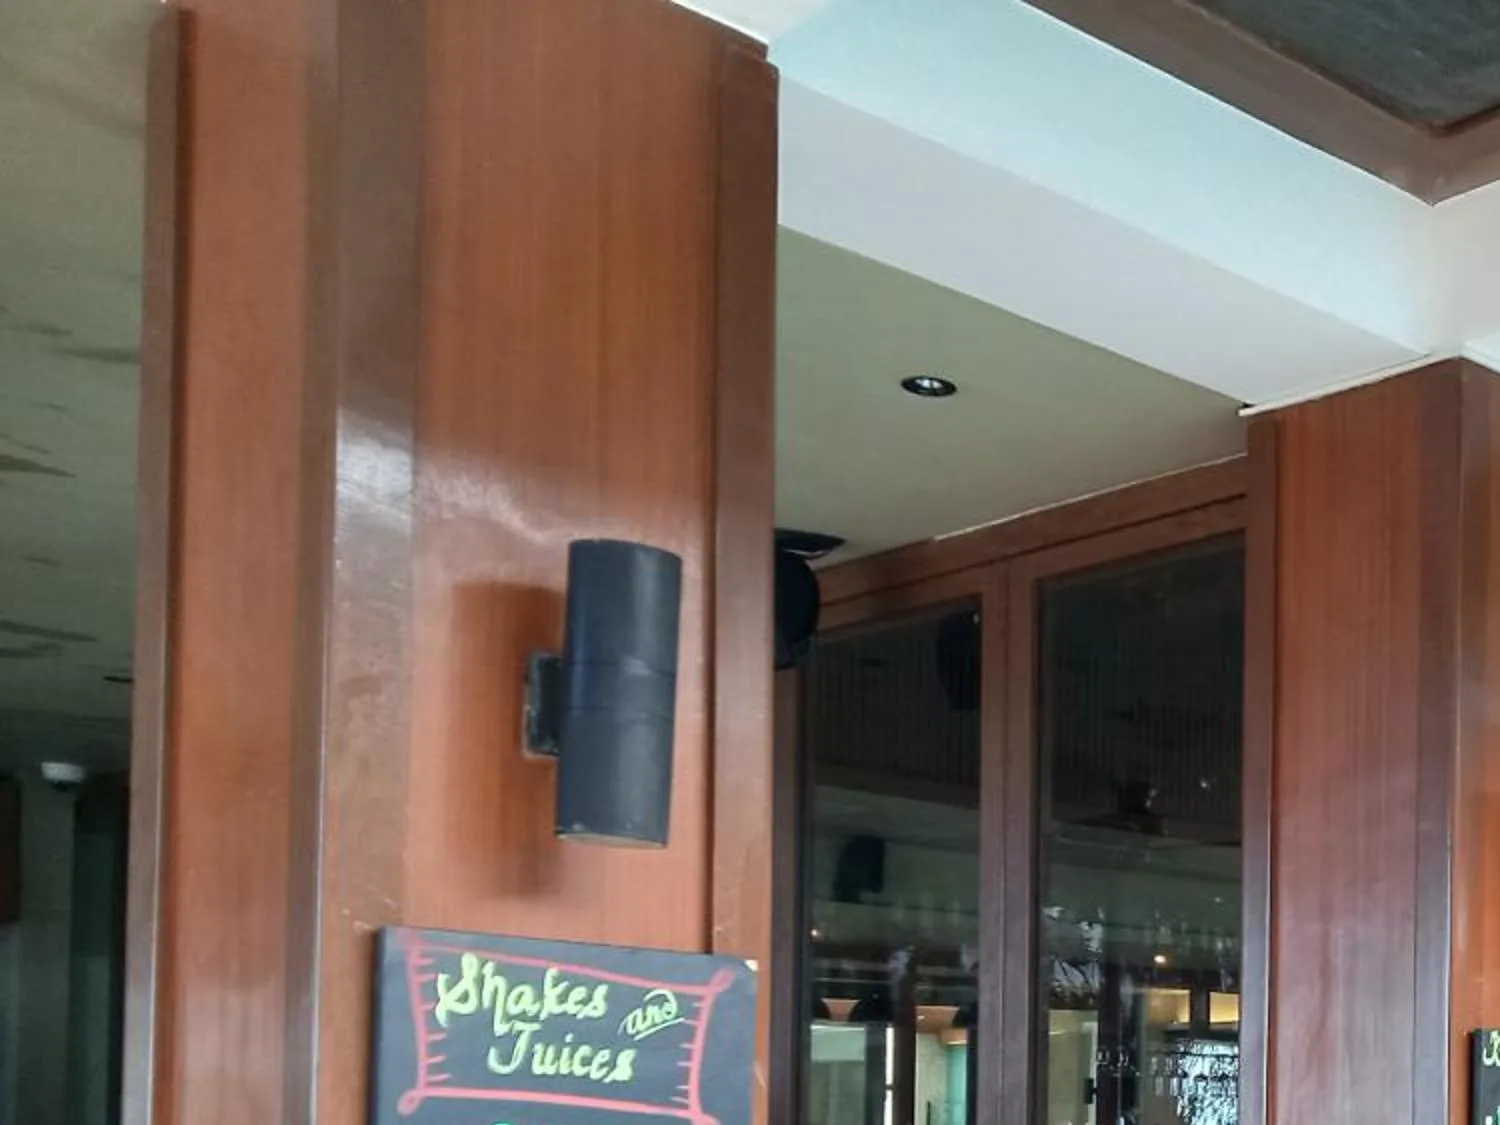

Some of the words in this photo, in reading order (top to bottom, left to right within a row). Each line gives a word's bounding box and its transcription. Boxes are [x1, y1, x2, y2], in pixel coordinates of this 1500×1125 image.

[435, 952, 608, 1035] Shakes
[618, 988, 682, 1039] and
[487, 1020, 636, 1081] Juices
